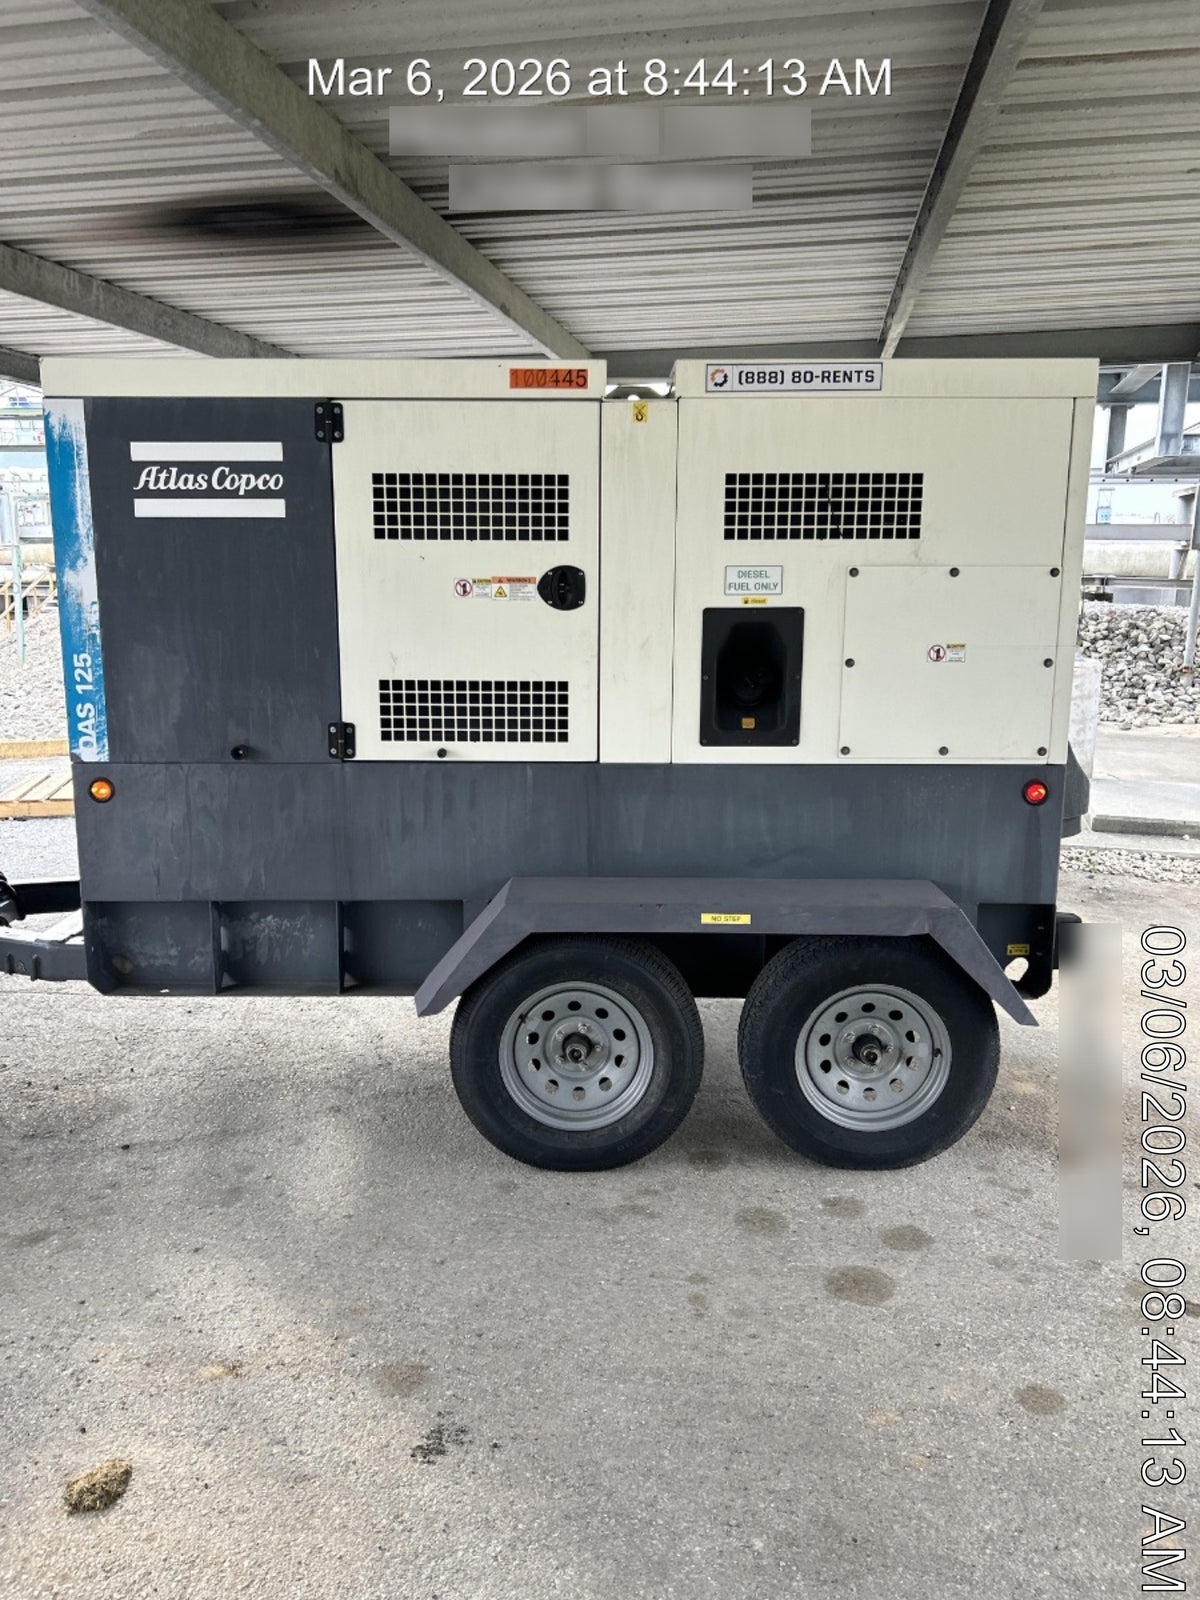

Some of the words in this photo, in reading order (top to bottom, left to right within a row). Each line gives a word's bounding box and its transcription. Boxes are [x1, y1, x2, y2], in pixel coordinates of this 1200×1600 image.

[511, 369, 588, 388] 100445
[738, 370, 785, 385] (888)
[791, 370, 875, 384] 80-RENTS
[133, 466, 208, 490] Atlas
[211, 466, 284, 495] Copco
[737, 570, 770, 579] DIESEL
[728, 582, 751, 591] FUEL
[754, 582, 779, 591] ONLY
[73, 653, 93, 695] 125
